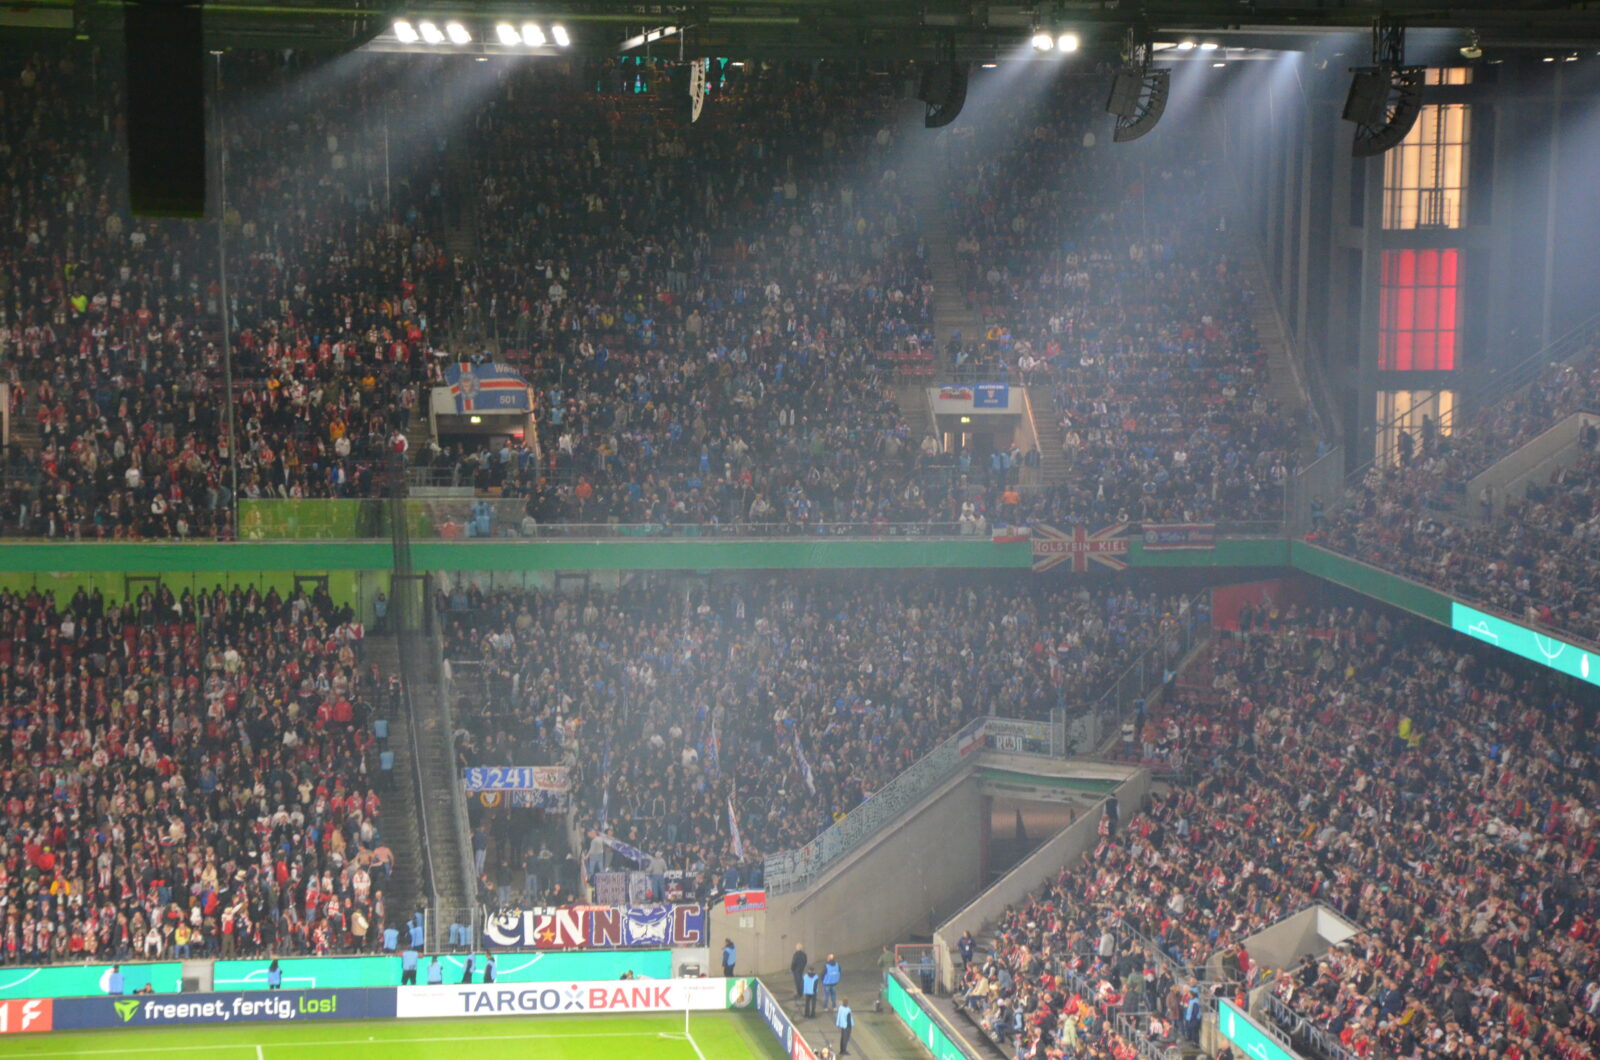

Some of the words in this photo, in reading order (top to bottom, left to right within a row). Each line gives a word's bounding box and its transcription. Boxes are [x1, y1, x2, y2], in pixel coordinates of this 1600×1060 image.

[1098, 540, 1127, 552] KIEL
[490, 768, 531, 789] 241
[143, 1000, 230, 1021] freenet,
[232, 996, 296, 1019] fertig,
[298, 994, 337, 1014] los!
[458, 988, 562, 1013] TARGO
[588, 985, 672, 1009] BANK
